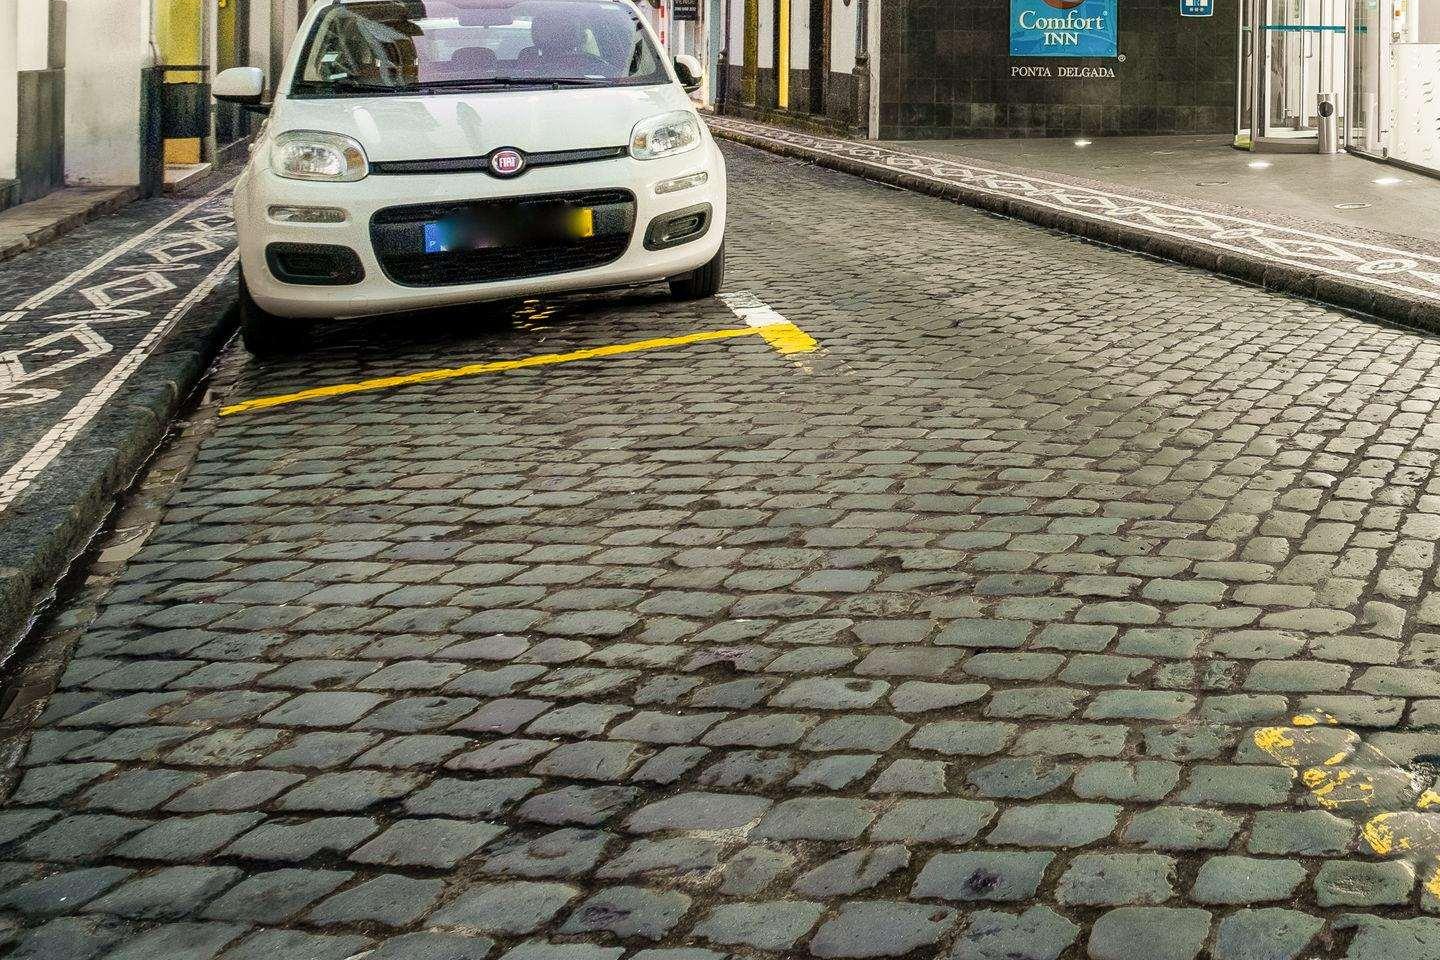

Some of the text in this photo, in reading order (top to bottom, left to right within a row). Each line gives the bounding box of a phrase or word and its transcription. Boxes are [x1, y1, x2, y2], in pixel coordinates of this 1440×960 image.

[1019, 9, 1105, 31] Comfort
[1043, 32, 1079, 46] INN
[1011, 66, 1116, 78] PONTA DELGADA
[499, 156, 516, 168] FIAT
